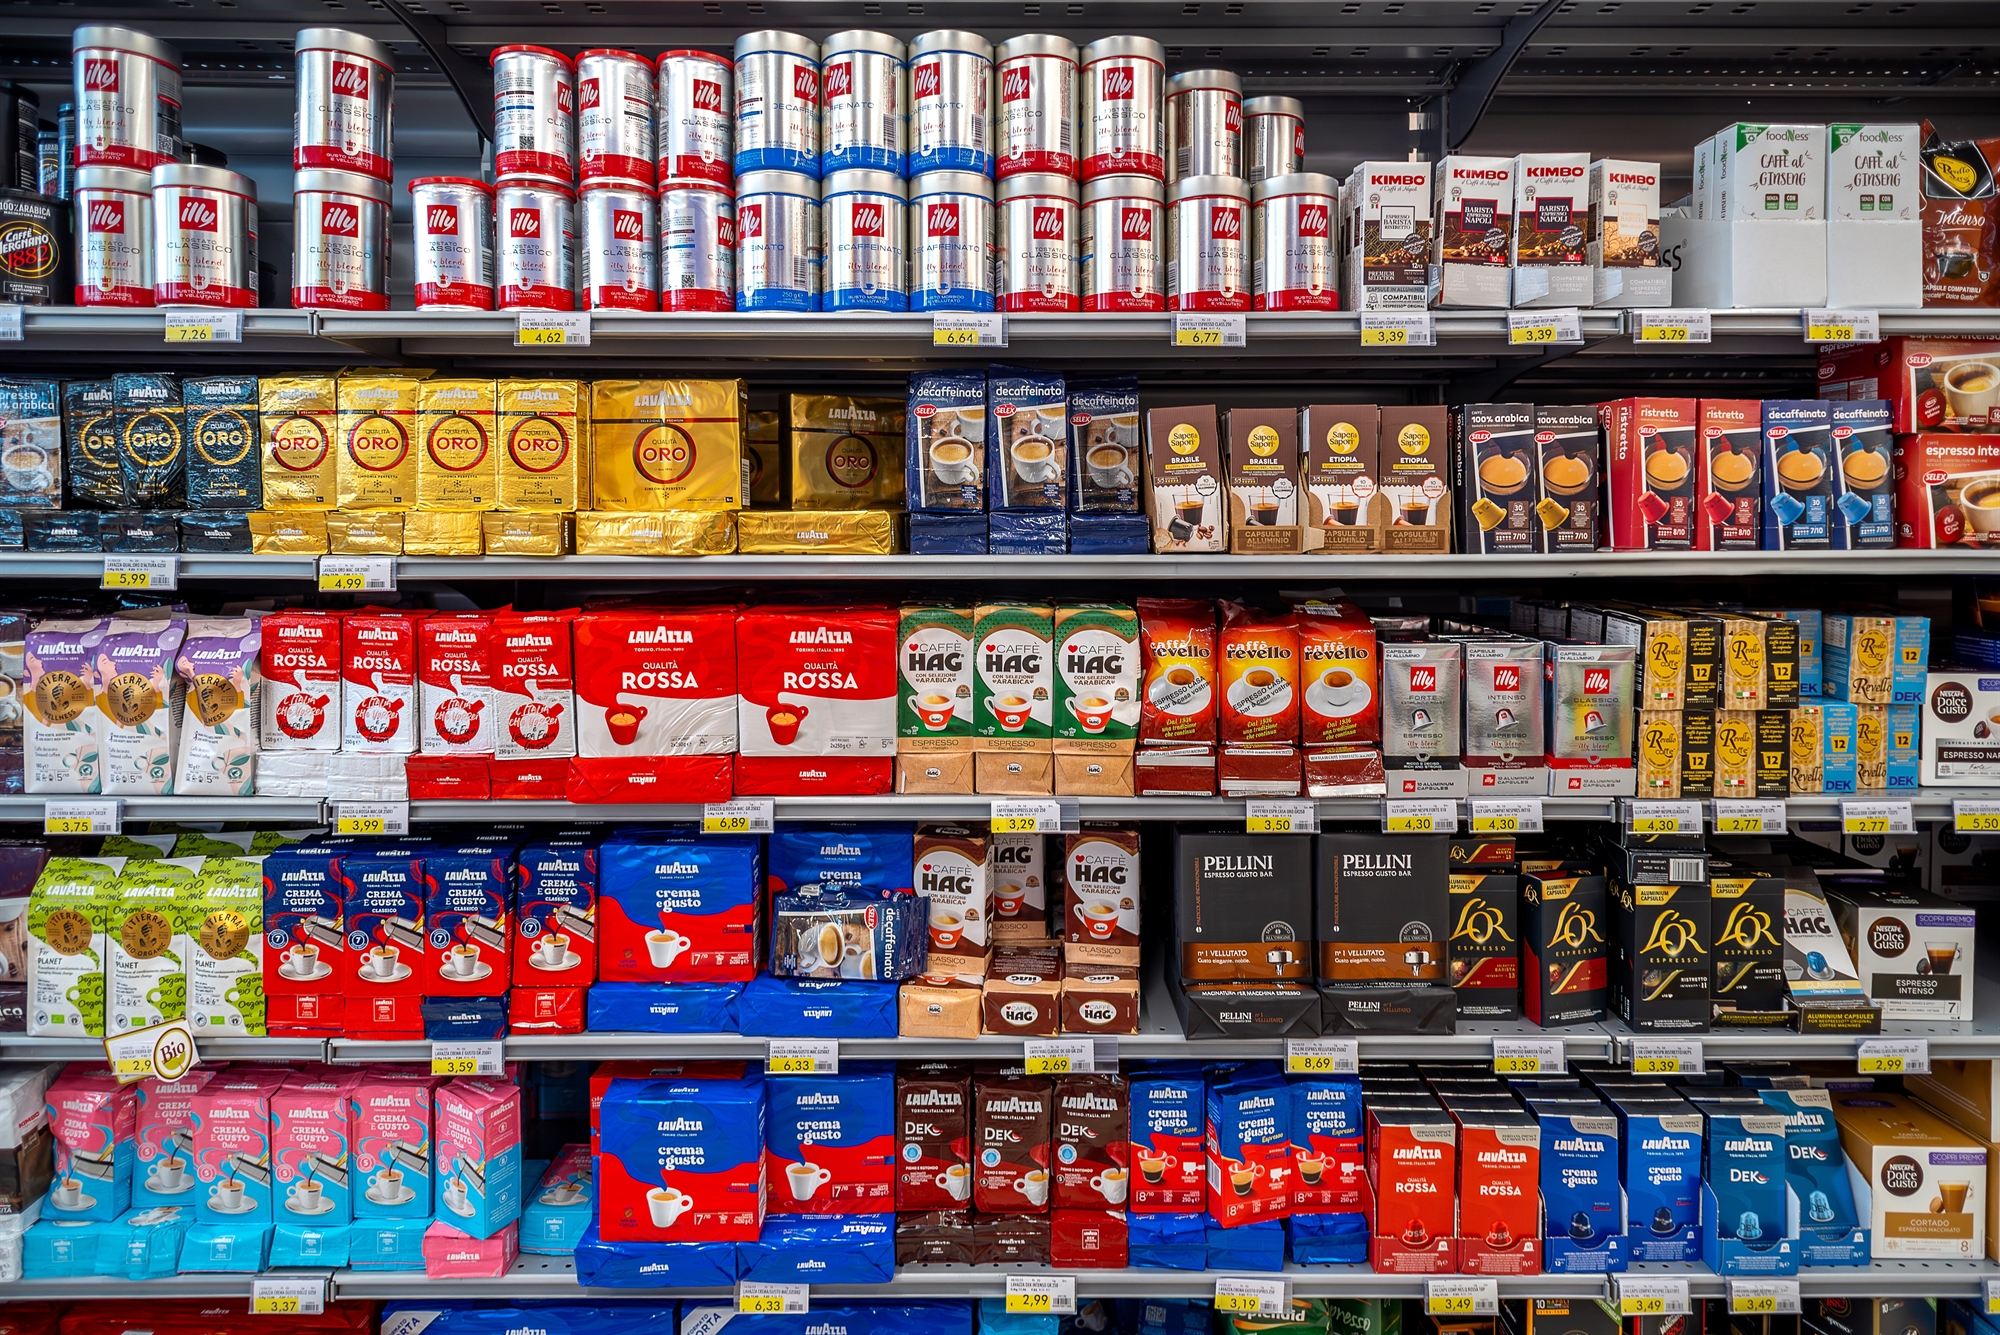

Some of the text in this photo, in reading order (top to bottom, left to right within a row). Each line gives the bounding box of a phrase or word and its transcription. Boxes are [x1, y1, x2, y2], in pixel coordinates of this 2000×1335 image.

[85, 62, 118, 89] illy
[333, 65, 367, 95] illy
[1371, 175, 1425, 185] KIMBO
[1453, 169, 1509, 181] KIMBO
[1609, 173, 1656, 186] KIMBO
[181, 201, 215, 228] illy
[1464, 206, 1494, 215] BARISTA
[428, 208, 455, 230] illy
[616, 211, 642, 234] illy
[1465, 215, 1492, 225] NAPOLI
[1935, 209, 1986, 227] Intenso
[6, 227, 32, 242] CAFFÈ
[167, 242, 233, 253] CLASSICO
[8, 244, 49, 268] 1882
[1947, 285, 1982, 294] COMPATIBILI
[180, 329, 207, 341] 7,26
[535, 332, 562, 345] 4,62
[947, 332, 973, 345] 6,64
[1192, 331, 1219, 345] 6,77
[1377, 331, 1404, 345] 3,39
[1526, 329, 1552, 343] 3,39
[517, 388, 560, 401] LAVAZZA
[916, 385, 984, 399] decaffeinato
[995, 384, 1063, 397] decaffeinato
[634, 390, 693, 407] LAVAZZA
[828, 405, 877, 421] LAVAZZA
[916, 406, 935, 416] SELEX
[1640, 408, 1679, 418] ristretto
[1768, 408, 1827, 419] decaffeinato
[1471, 414, 1529, 423] 100% arabica
[525, 428, 551, 436] QUALITÀ
[1768, 428, 1787, 436] SELEX
[202, 430, 244, 447] ORO
[651, 437, 677, 445] QUALITÀ
[517, 438, 560, 453] ORO
[643, 447, 687, 463] ORO
[1926, 446, 1975, 459] espresso
[1926, 472, 1945, 482] SELEX
[1513, 532, 1527, 541] 7/10
[1673, 528, 1685, 536] 8/10
[120, 573, 146, 585] 5,99
[334, 578, 362, 589] 4,99
[628, 626, 693, 644] LAVAZZA
[789, 626, 853, 644] LAVAZZA
[36, 641, 85, 655] LAVAZZA
[996, 641, 1040, 654] CAFFÈ
[1226, 646, 1292, 661] revello
[985, 655, 1040, 673] HAG
[1696, 668, 1707, 677] 12
[1233, 676, 1286, 711] ESPRESSO CASA
[1894, 691, 1922, 702] DEK
[1937, 695, 1967, 706] Dolce
[1937, 704, 1968, 715] Gusto
[43, 709, 77, 723] WELLNESS
[988, 740, 1035, 748] ESPRESSO
[62, 821, 89, 833] 3,75
[352, 820, 379, 832] 3,99
[719, 817, 746, 830] 6,89
[1008, 819, 1035, 832] 3,29
[1264, 820, 1290, 832] 3,50
[1404, 818, 1431, 830] 4,30
[1488, 818, 1515, 830] 4,30
[1648, 820, 1674, 832] 4,30
[1732, 819, 1759, 832] 2,77
[1973, 818, 1999, 830] 5,50
[1086, 854, 1127, 866] CAFFÈ
[1203, 855, 1273, 871] PELLINI
[654, 861, 699, 875] LAVAZZA
[363, 870, 407, 883] LAVAZZA
[1075, 865, 1126, 884] HAG
[1204, 871, 1235, 879] ESPRESSO
[922, 873, 971, 894] HAG
[46, 884, 95, 897] LAVAZZA
[366, 890, 402, 899] CREMA
[656, 887, 700, 899] crema
[370, 898, 405, 907] GUSTO
[663, 897, 701, 913] gusto
[1946, 915, 1972, 923] PREMIO
[1873, 931, 1904, 942] Dolce
[883, 908, 895, 979] decaffeinato
[1874, 941, 1905, 950] Gusto
[1079, 945, 1121, 955] CLASSICO
[1896, 979, 1938, 988] ESPRESSO
[1899, 987, 1934, 995] INTENSO
[160, 1042, 186, 1064] Bio
[447, 1061, 474, 1074] 3,59
[783, 1061, 810, 1073] 6,33
[1041, 1060, 1068, 1072] 2,69
[1304, 1058, 1331, 1070] 8,69
[1510, 1060, 1536, 1072] 3,39
[1648, 1060, 1675, 1072] 3,39
[1876, 1059, 1902, 1071] 2,99
[370, 1094, 411, 1107] LAVAZZA
[373, 1115, 407, 1123] CREMA
[1148, 1109, 1188, 1118] crema
[377, 1123, 410, 1131] GUSTO
[905, 1121, 934, 1135] DEK
[1173, 1126, 1198, 1136] Espresso
[382, 1130, 398, 1139] Dolce
[657, 1146, 704, 1156] crema
[665, 1155, 705, 1171] gusto
[1562, 1168, 1597, 1177] crema
[1730, 1168, 1758, 1183] DEK
[1887, 1169, 1917, 1182] Dolce
[1887, 1178, 1918, 1190] Gusto
[1910, 1218, 1949, 1227] CORTADO
[270, 1301, 297, 1313] 3,37
[754, 1300, 781, 1312] 6,33
[1022, 1294, 1049, 1308] 2,99
[1229, 1298, 1257, 1311] 3,19
[1445, 1298, 1471, 1311] 3,49
[1636, 1300, 1662, 1312] 3,49
[1747, 1299, 1773, 1311] 3,49
